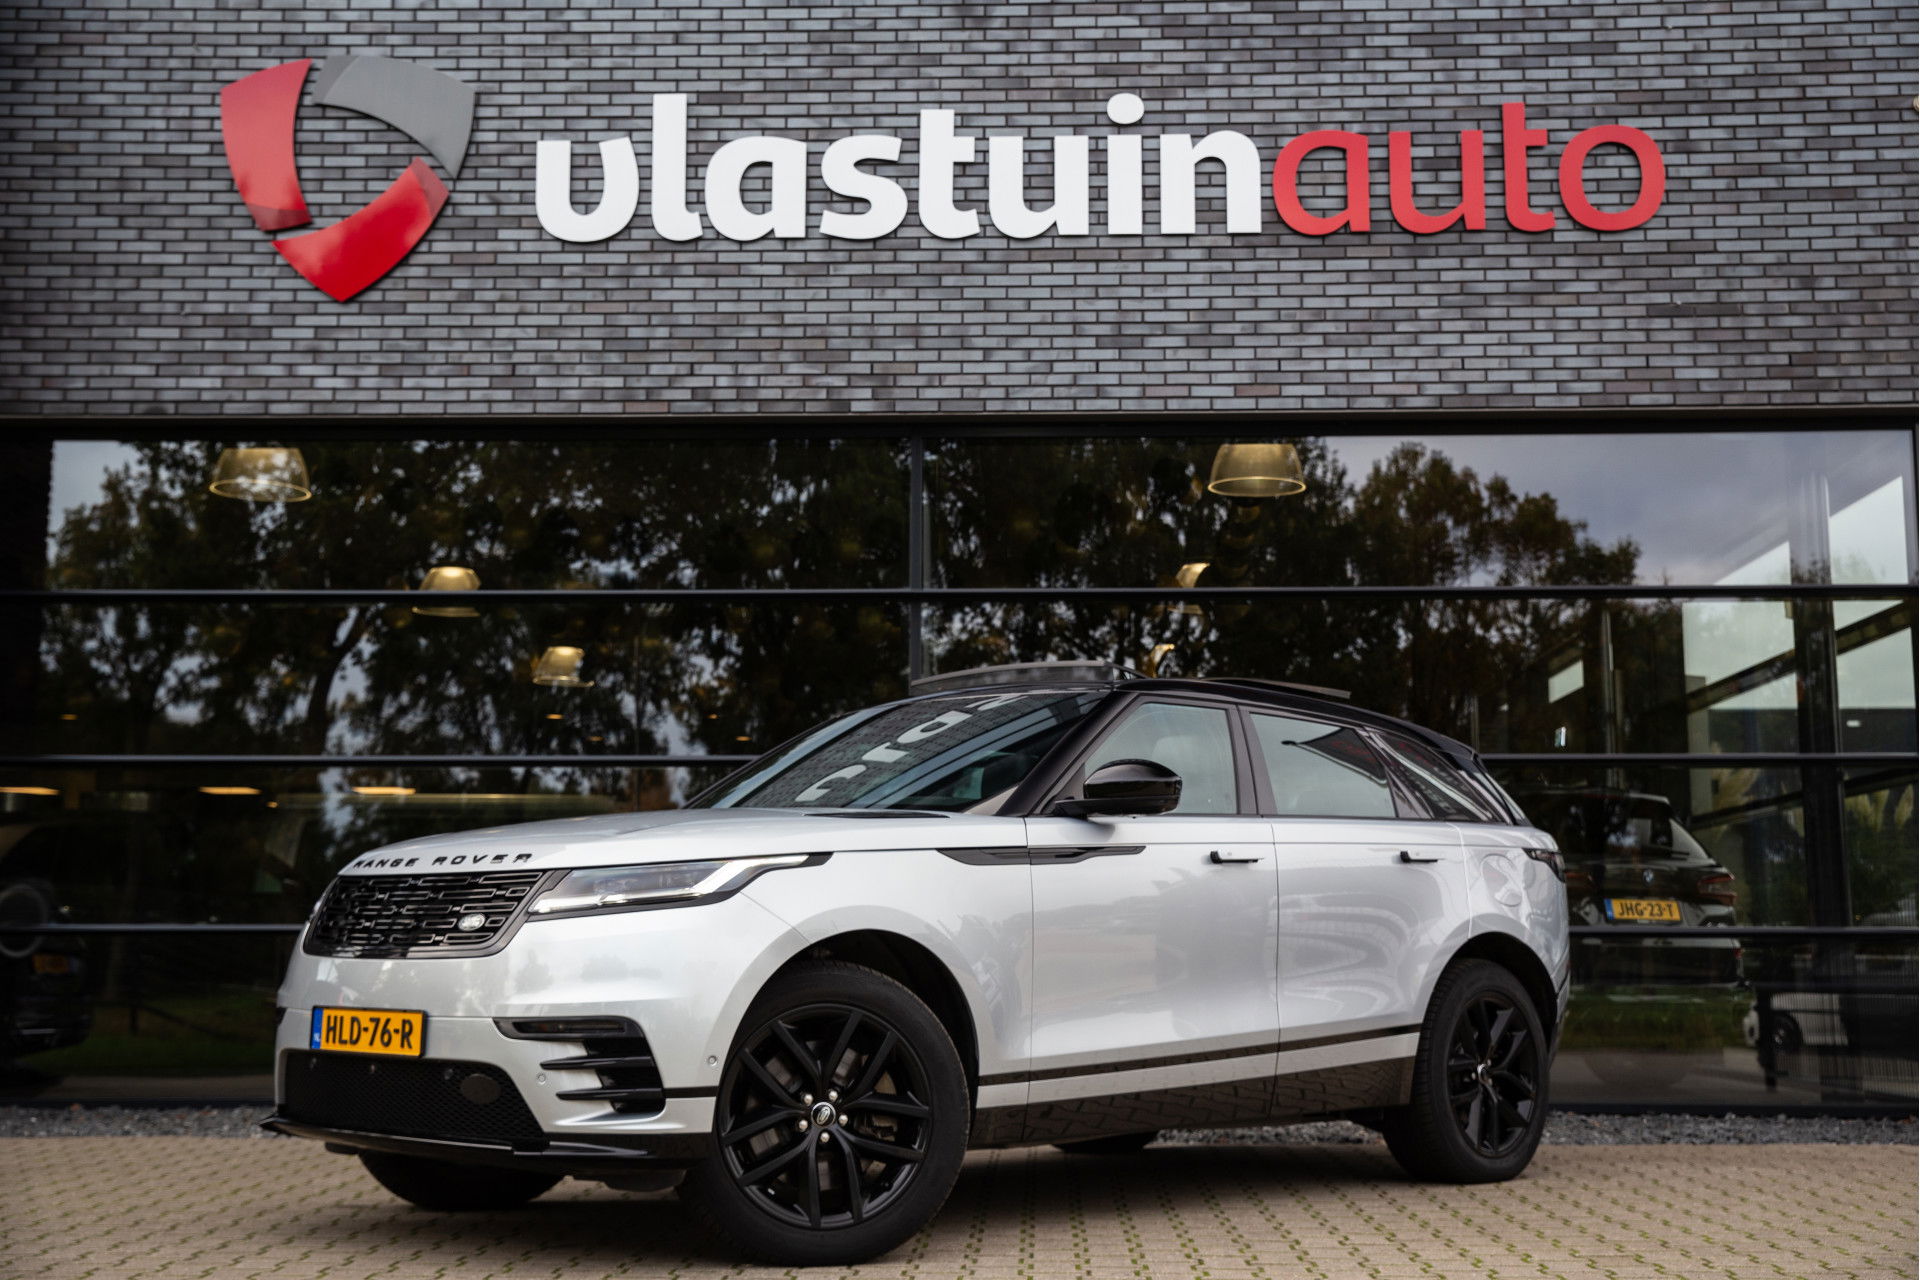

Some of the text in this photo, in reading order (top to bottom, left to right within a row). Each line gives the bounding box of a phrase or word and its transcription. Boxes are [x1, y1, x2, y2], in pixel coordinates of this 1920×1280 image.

[353, 853, 532, 869] RANGE ROVER
[325, 1015, 413, 1049] HLD-76-R
